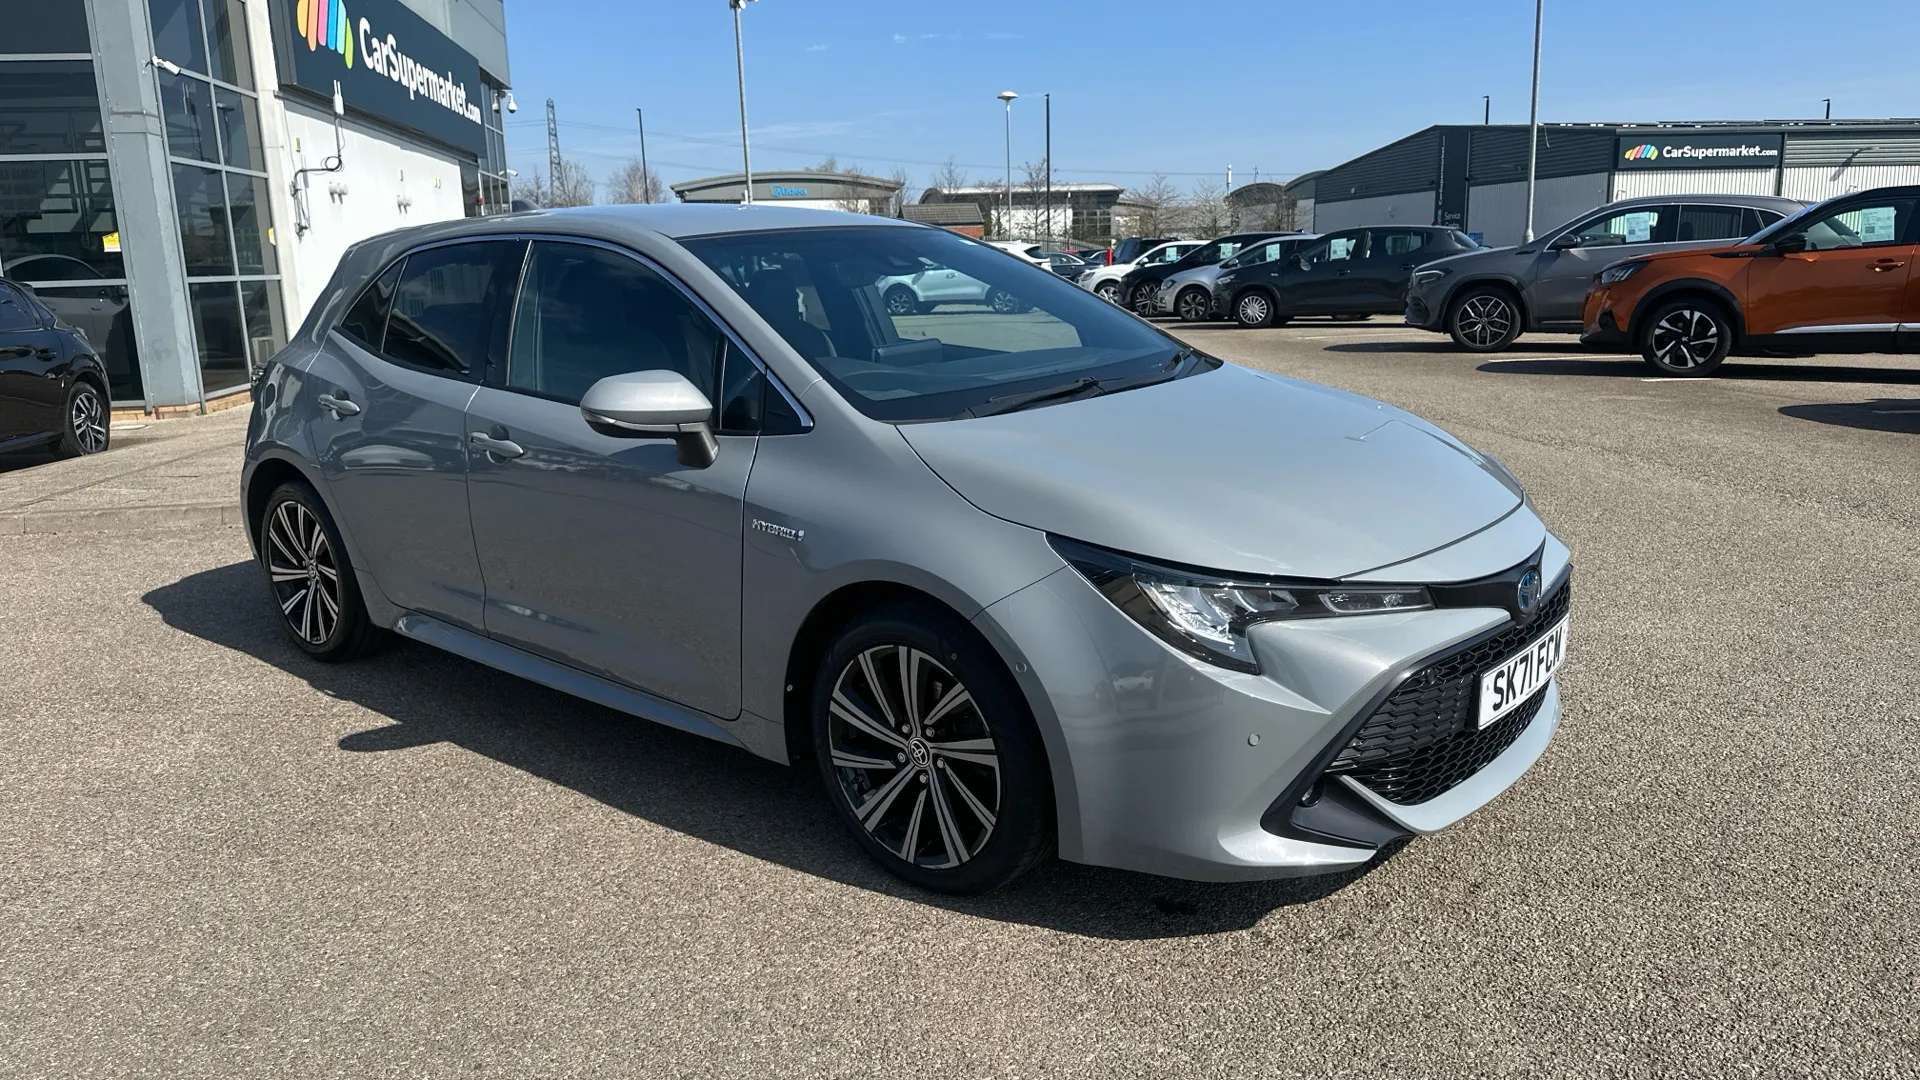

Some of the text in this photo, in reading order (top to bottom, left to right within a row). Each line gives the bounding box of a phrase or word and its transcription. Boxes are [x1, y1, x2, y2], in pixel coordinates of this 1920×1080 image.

[359, 16, 482, 125] CarSupermarket.com
[1662, 144, 1778, 159] CarSupermarket.com
[1492, 649, 1534, 712] SK71
